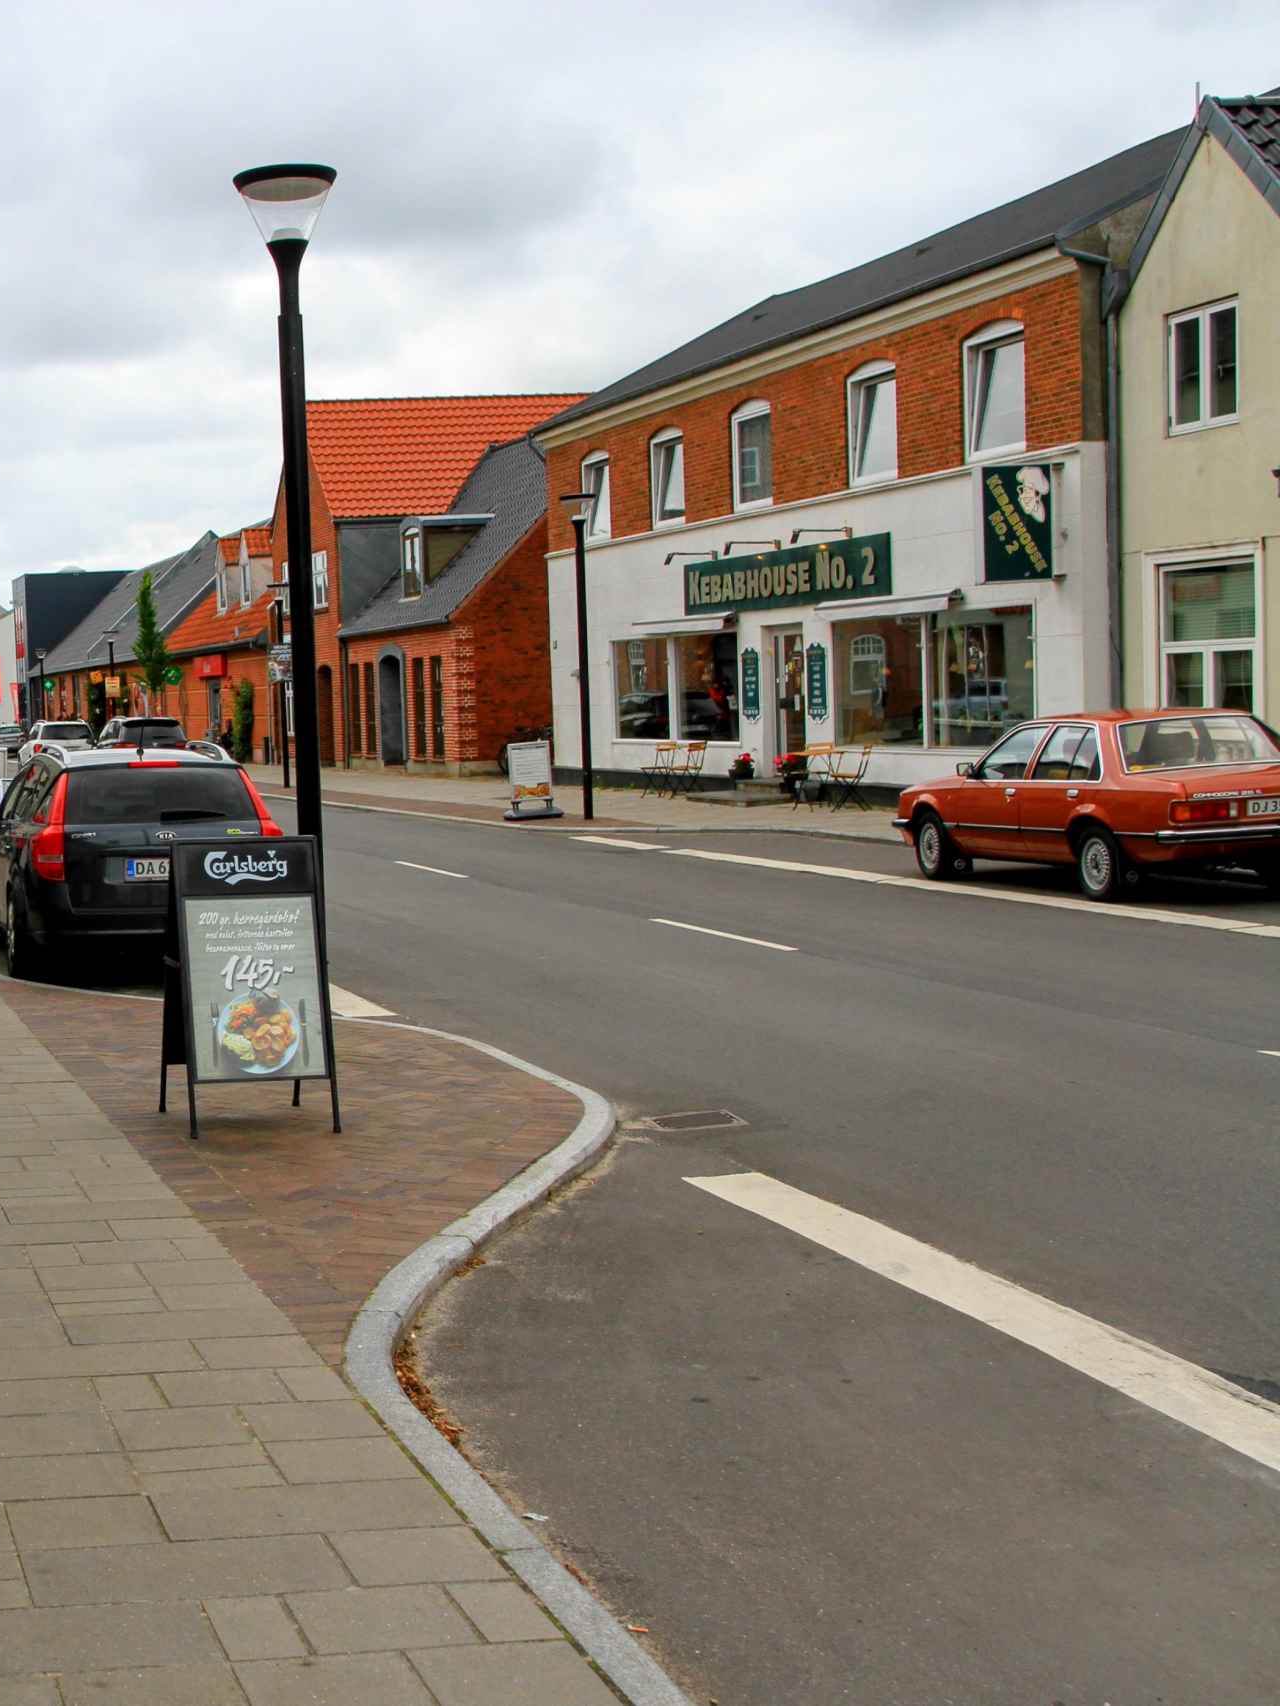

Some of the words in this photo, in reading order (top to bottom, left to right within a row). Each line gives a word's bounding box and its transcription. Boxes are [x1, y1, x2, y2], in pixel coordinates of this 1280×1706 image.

[985, 474, 1048, 573] KEBABHOUSE
[1004, 540, 1020, 555] 2
[688, 561, 810, 605] KEBABHOUSE
[861, 547, 876, 586] 2
[1271, 800, 1280, 813] 3
[158, 832, 175, 840] KIA
[135, 861, 156, 875] DA
[158, 859, 170, 875] 6
[203, 850, 288, 881] Carlsberg
